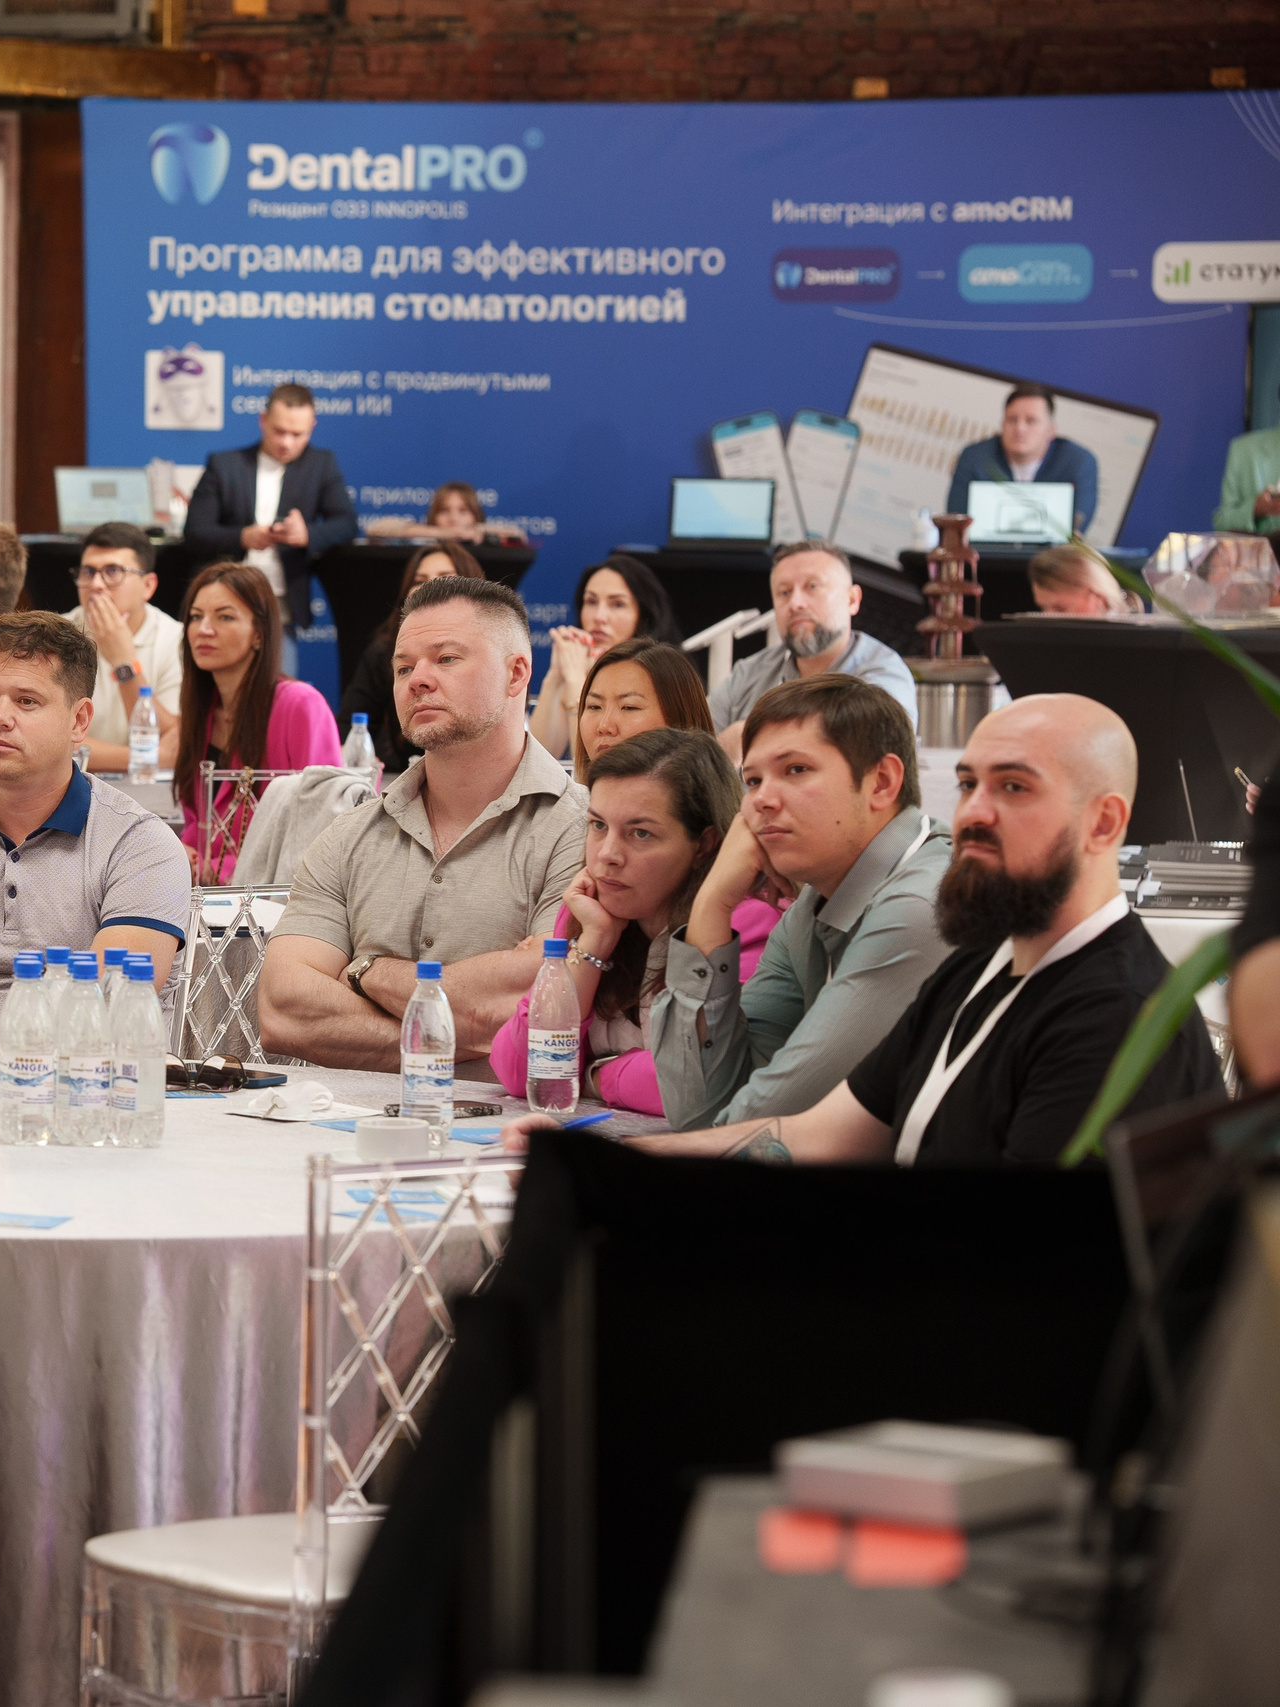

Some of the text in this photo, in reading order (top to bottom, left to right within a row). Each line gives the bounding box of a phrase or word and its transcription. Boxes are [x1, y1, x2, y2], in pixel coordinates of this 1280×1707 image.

[247, 143, 528, 192] DentalPRO
[248, 199, 328, 219] Резидент
[372, 200, 469, 220] INNOPOLIS
[772, 196, 1073, 228] Интеграция с amoCRM
[149, 236, 726, 282] Программа для эффективного
[147, 287, 687, 326] управления стоматологией
[365, 371, 382, 390] с
[384, 371, 552, 396] продвинутыми
[356, 394, 393, 417] ИИ
[8, 1062, 49, 1072] KANGEN
